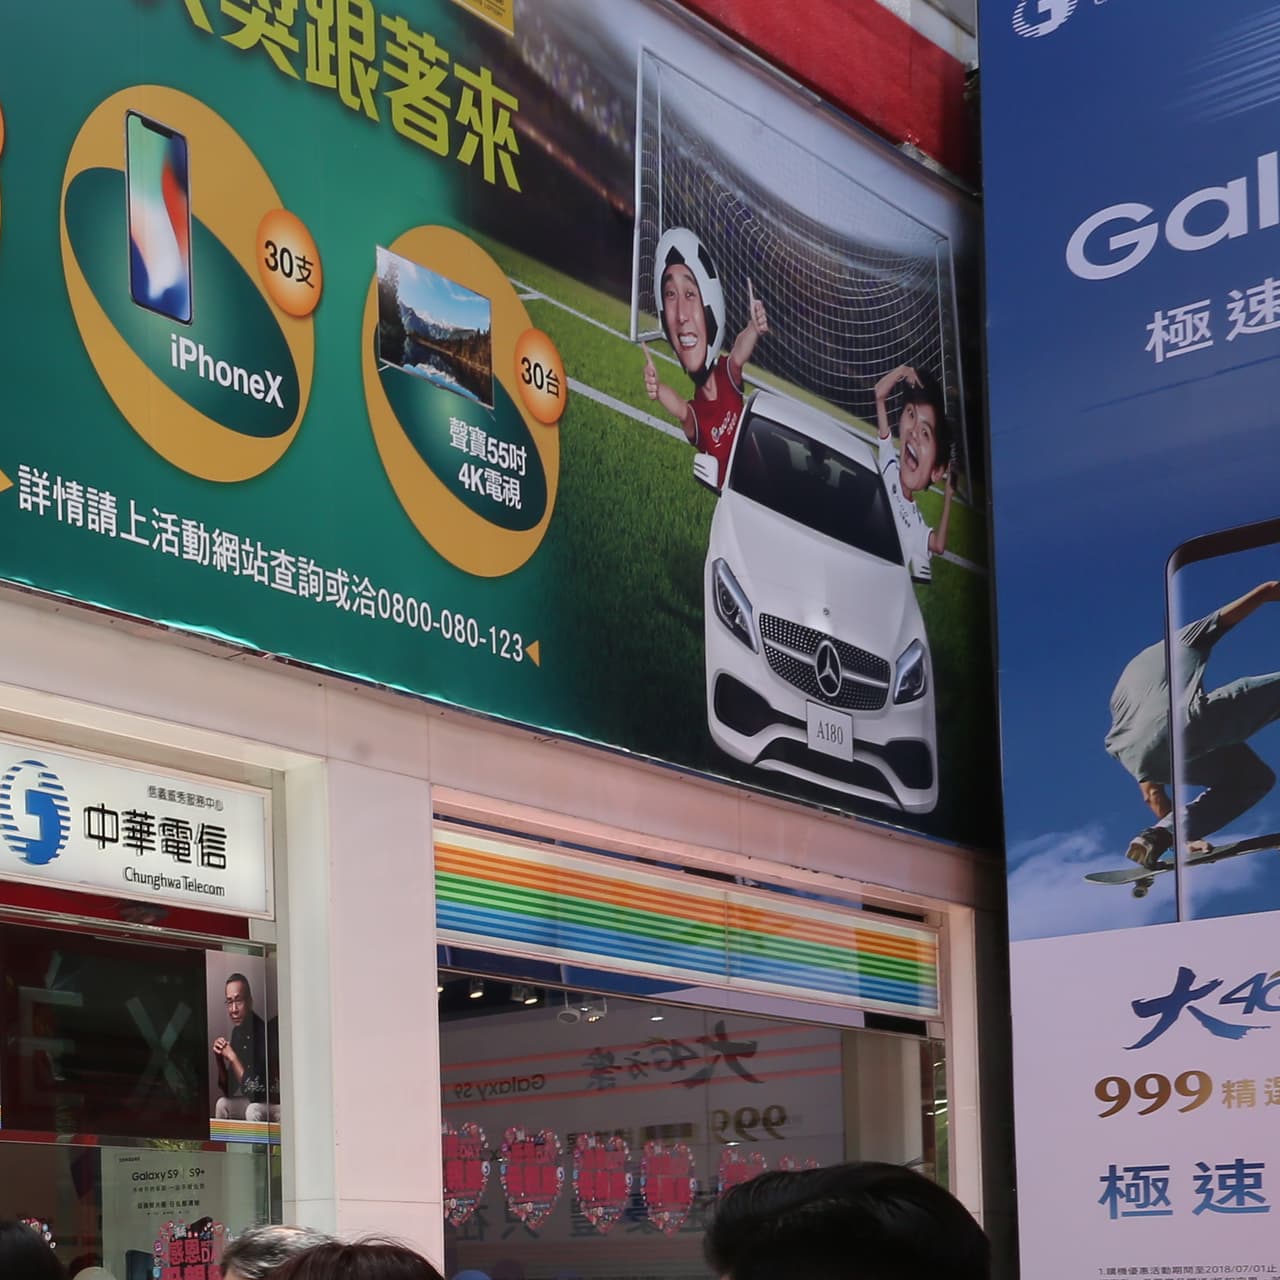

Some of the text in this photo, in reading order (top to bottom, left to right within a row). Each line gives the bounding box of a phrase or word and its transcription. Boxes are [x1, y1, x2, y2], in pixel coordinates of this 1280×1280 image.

[264, 239, 315, 289] 30支
[170, 333, 286, 408] iPhoneX
[520, 355, 561, 400] 30台
[448, 415, 527, 477] 聲寶55吋
[458, 467, 522, 511] 4K電視
[816, 719, 843, 745] A180
[83, 803, 228, 870] 中華電信
[124, 867, 225, 897] Chunghwa Telecom
[1095, 1070, 1213, 1118] 999
[132, 1171, 166, 1182] Galaxy
[167, 1169, 179, 1179] S9
[1098, 1158, 1272, 1221] 極速
